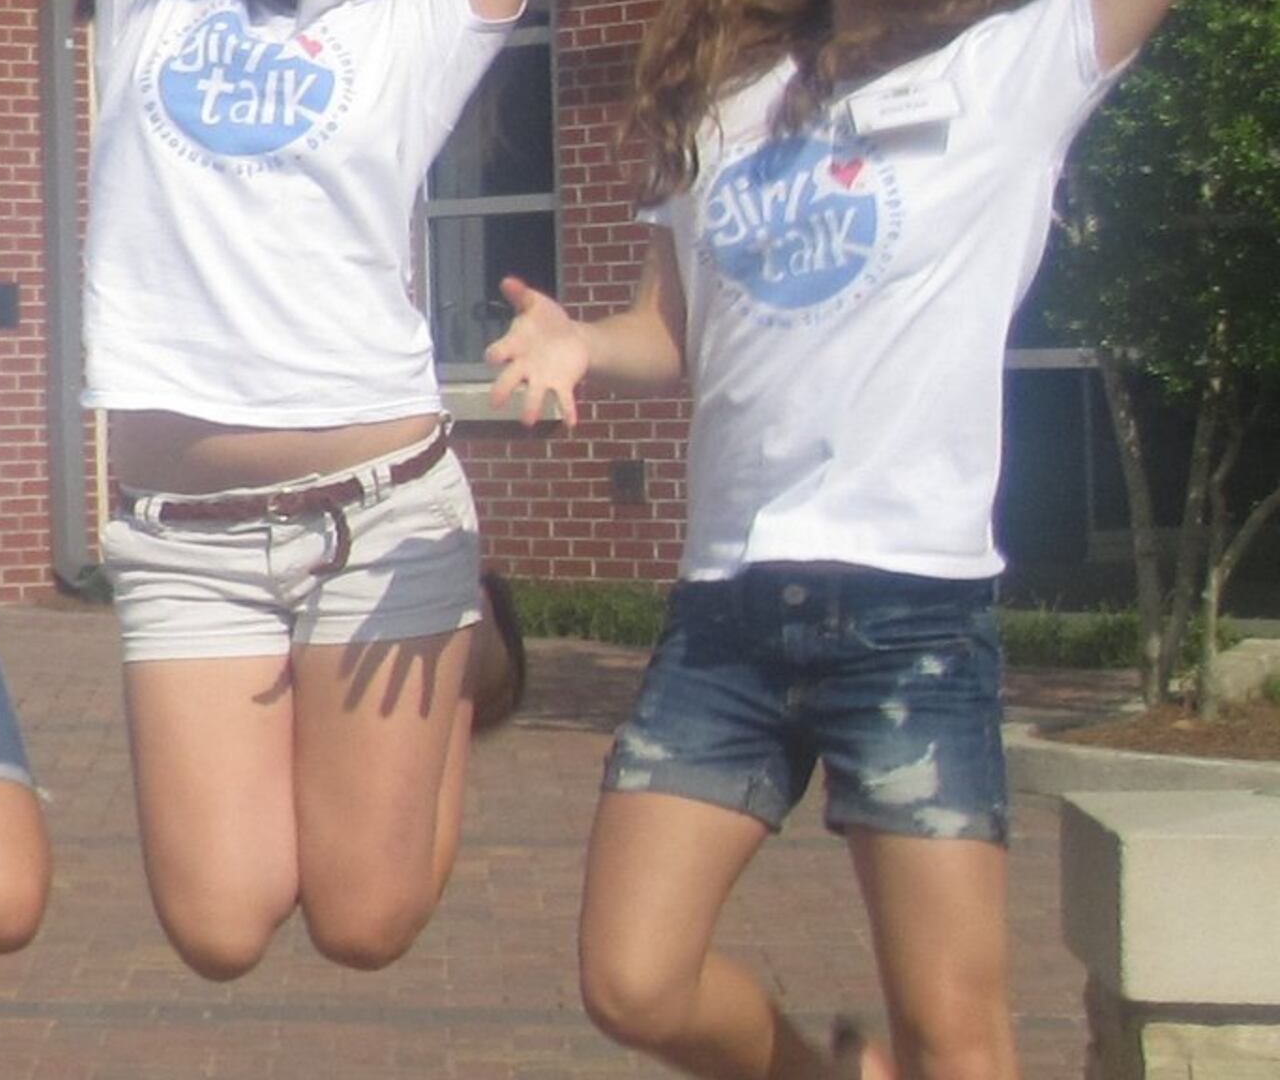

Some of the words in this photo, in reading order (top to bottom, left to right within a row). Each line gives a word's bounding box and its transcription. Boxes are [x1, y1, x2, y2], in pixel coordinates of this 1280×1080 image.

[170, 22, 265, 73] girl
[196, 67, 323, 127] talk
[704, 171, 810, 247] girl
[754, 208, 873, 283] talk
